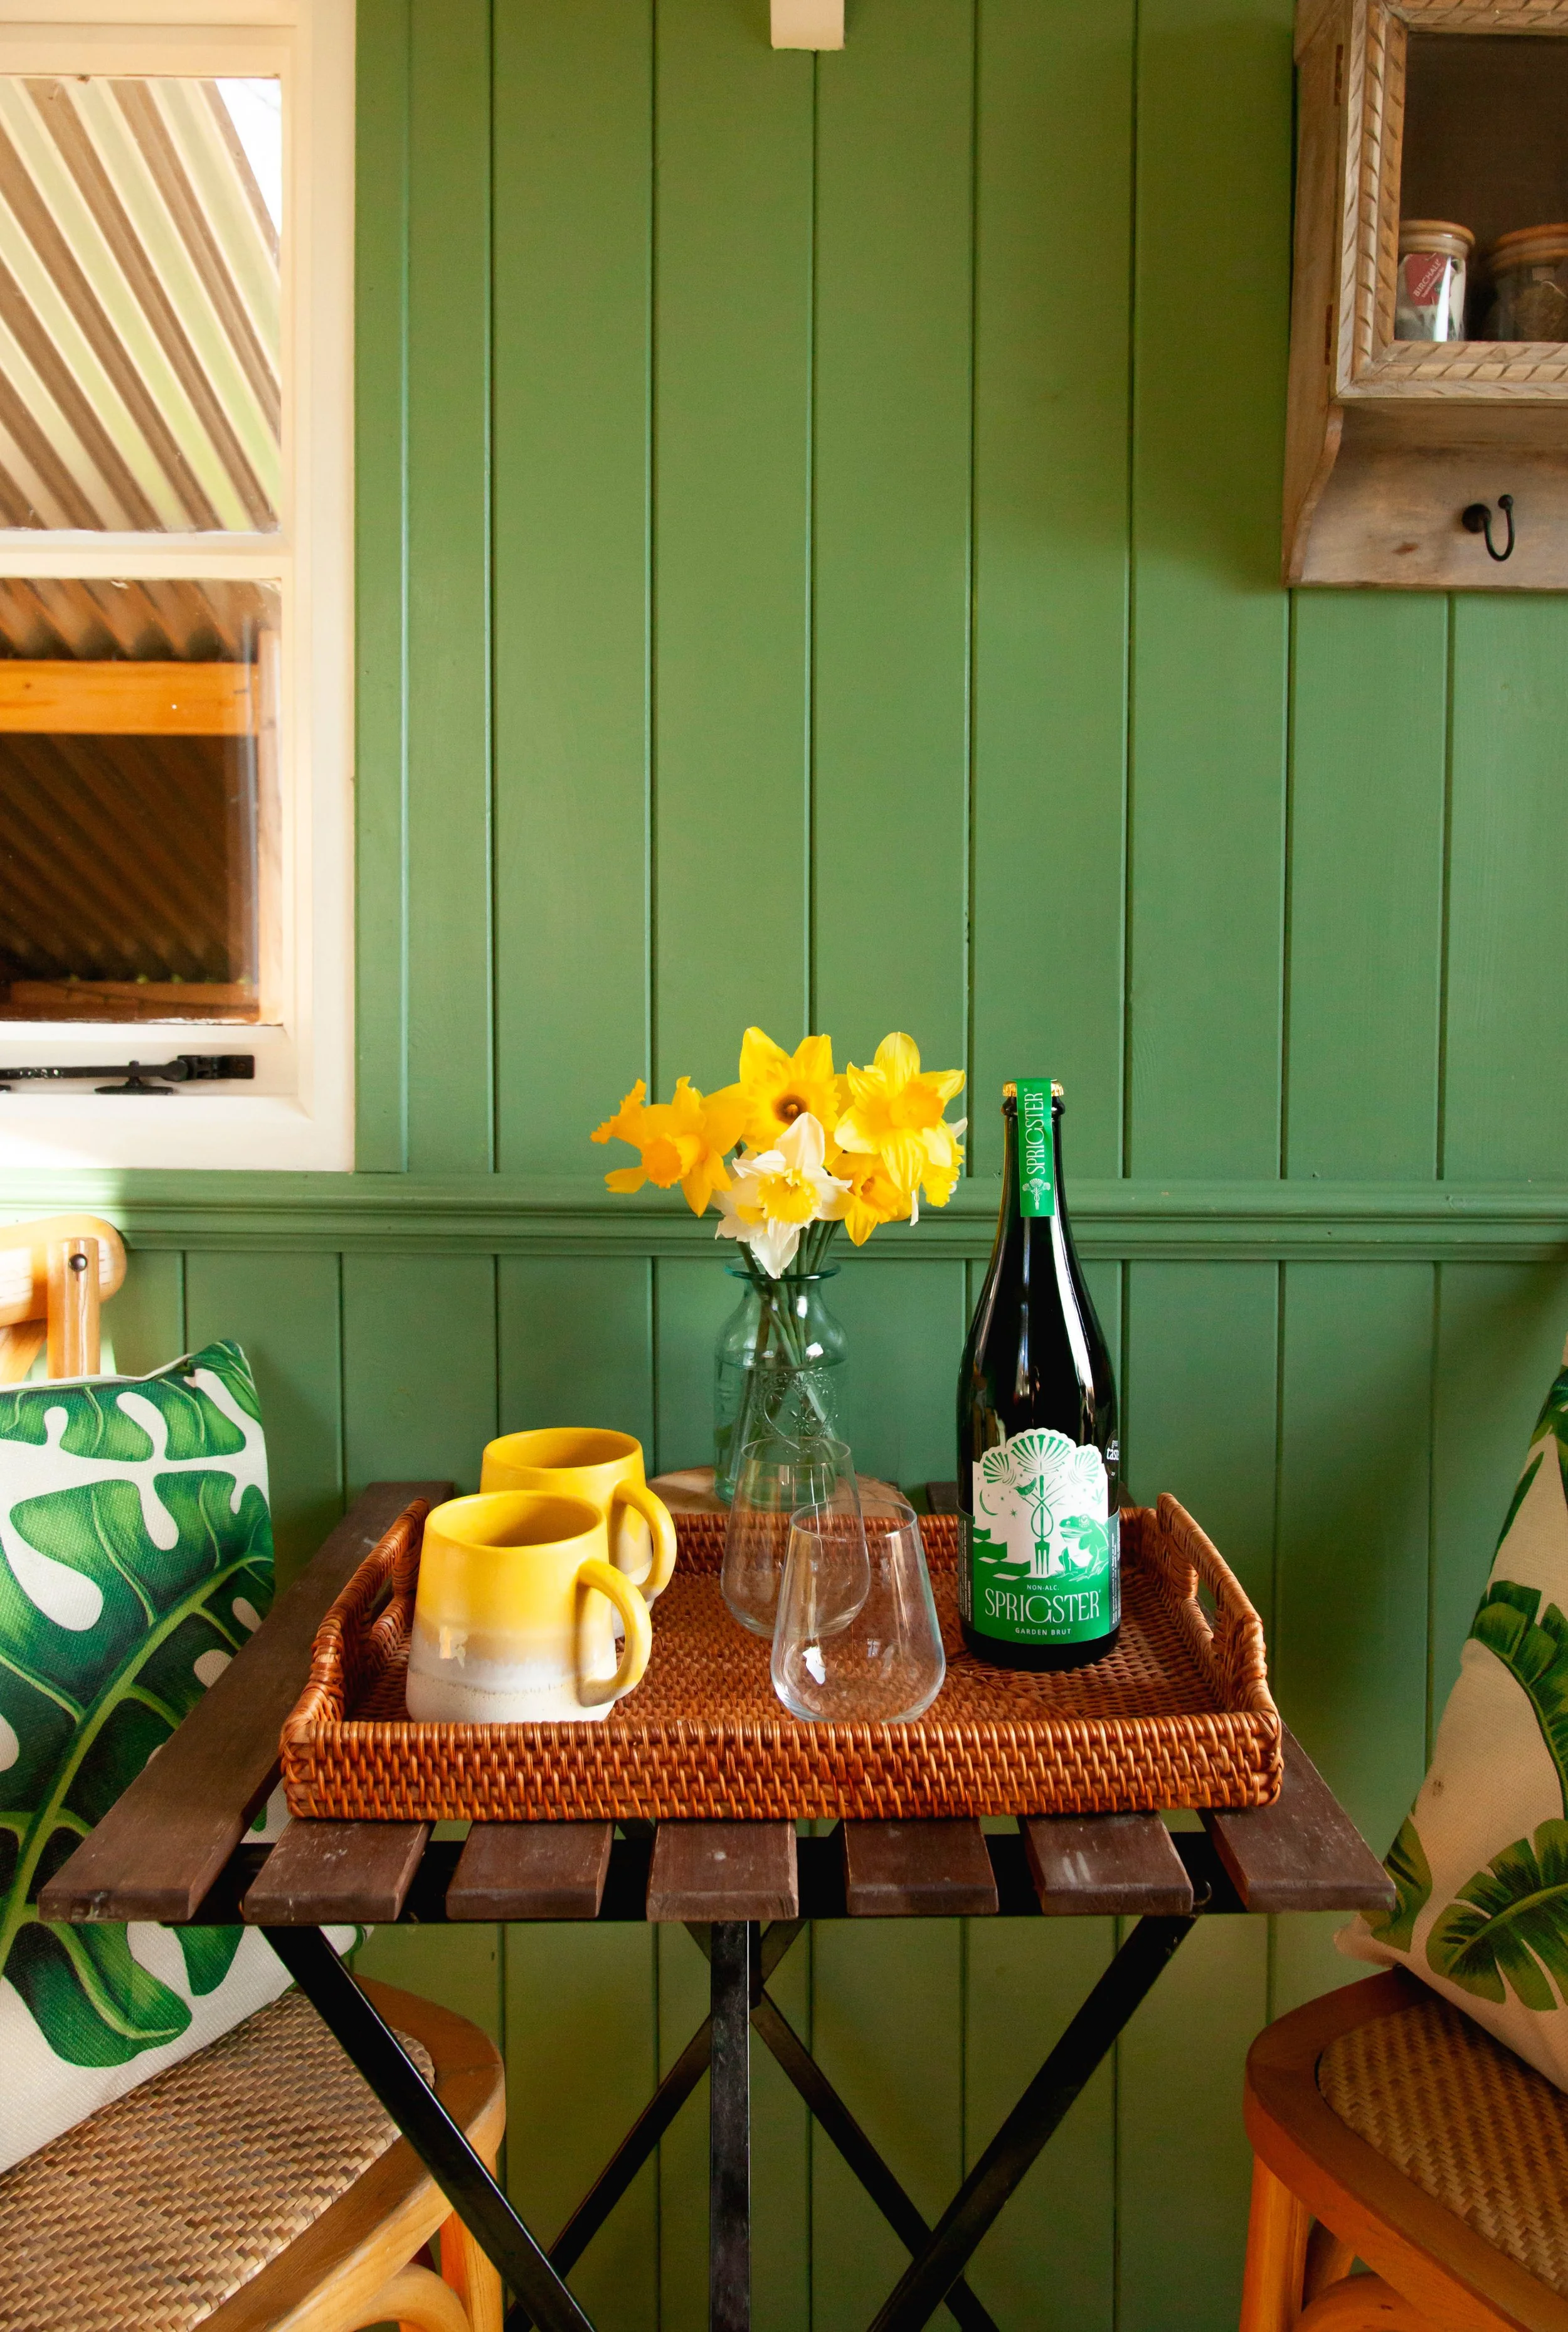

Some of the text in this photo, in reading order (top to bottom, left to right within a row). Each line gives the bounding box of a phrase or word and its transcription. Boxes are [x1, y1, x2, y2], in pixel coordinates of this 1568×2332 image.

[1413, 260, 1441, 297] BIRCHALL
[1024, 1092, 1046, 1174] SPRIGSTER
[985, 1588, 1099, 1623] SPRIGSTER
[1015, 1627, 1047, 1636] GARDEN
